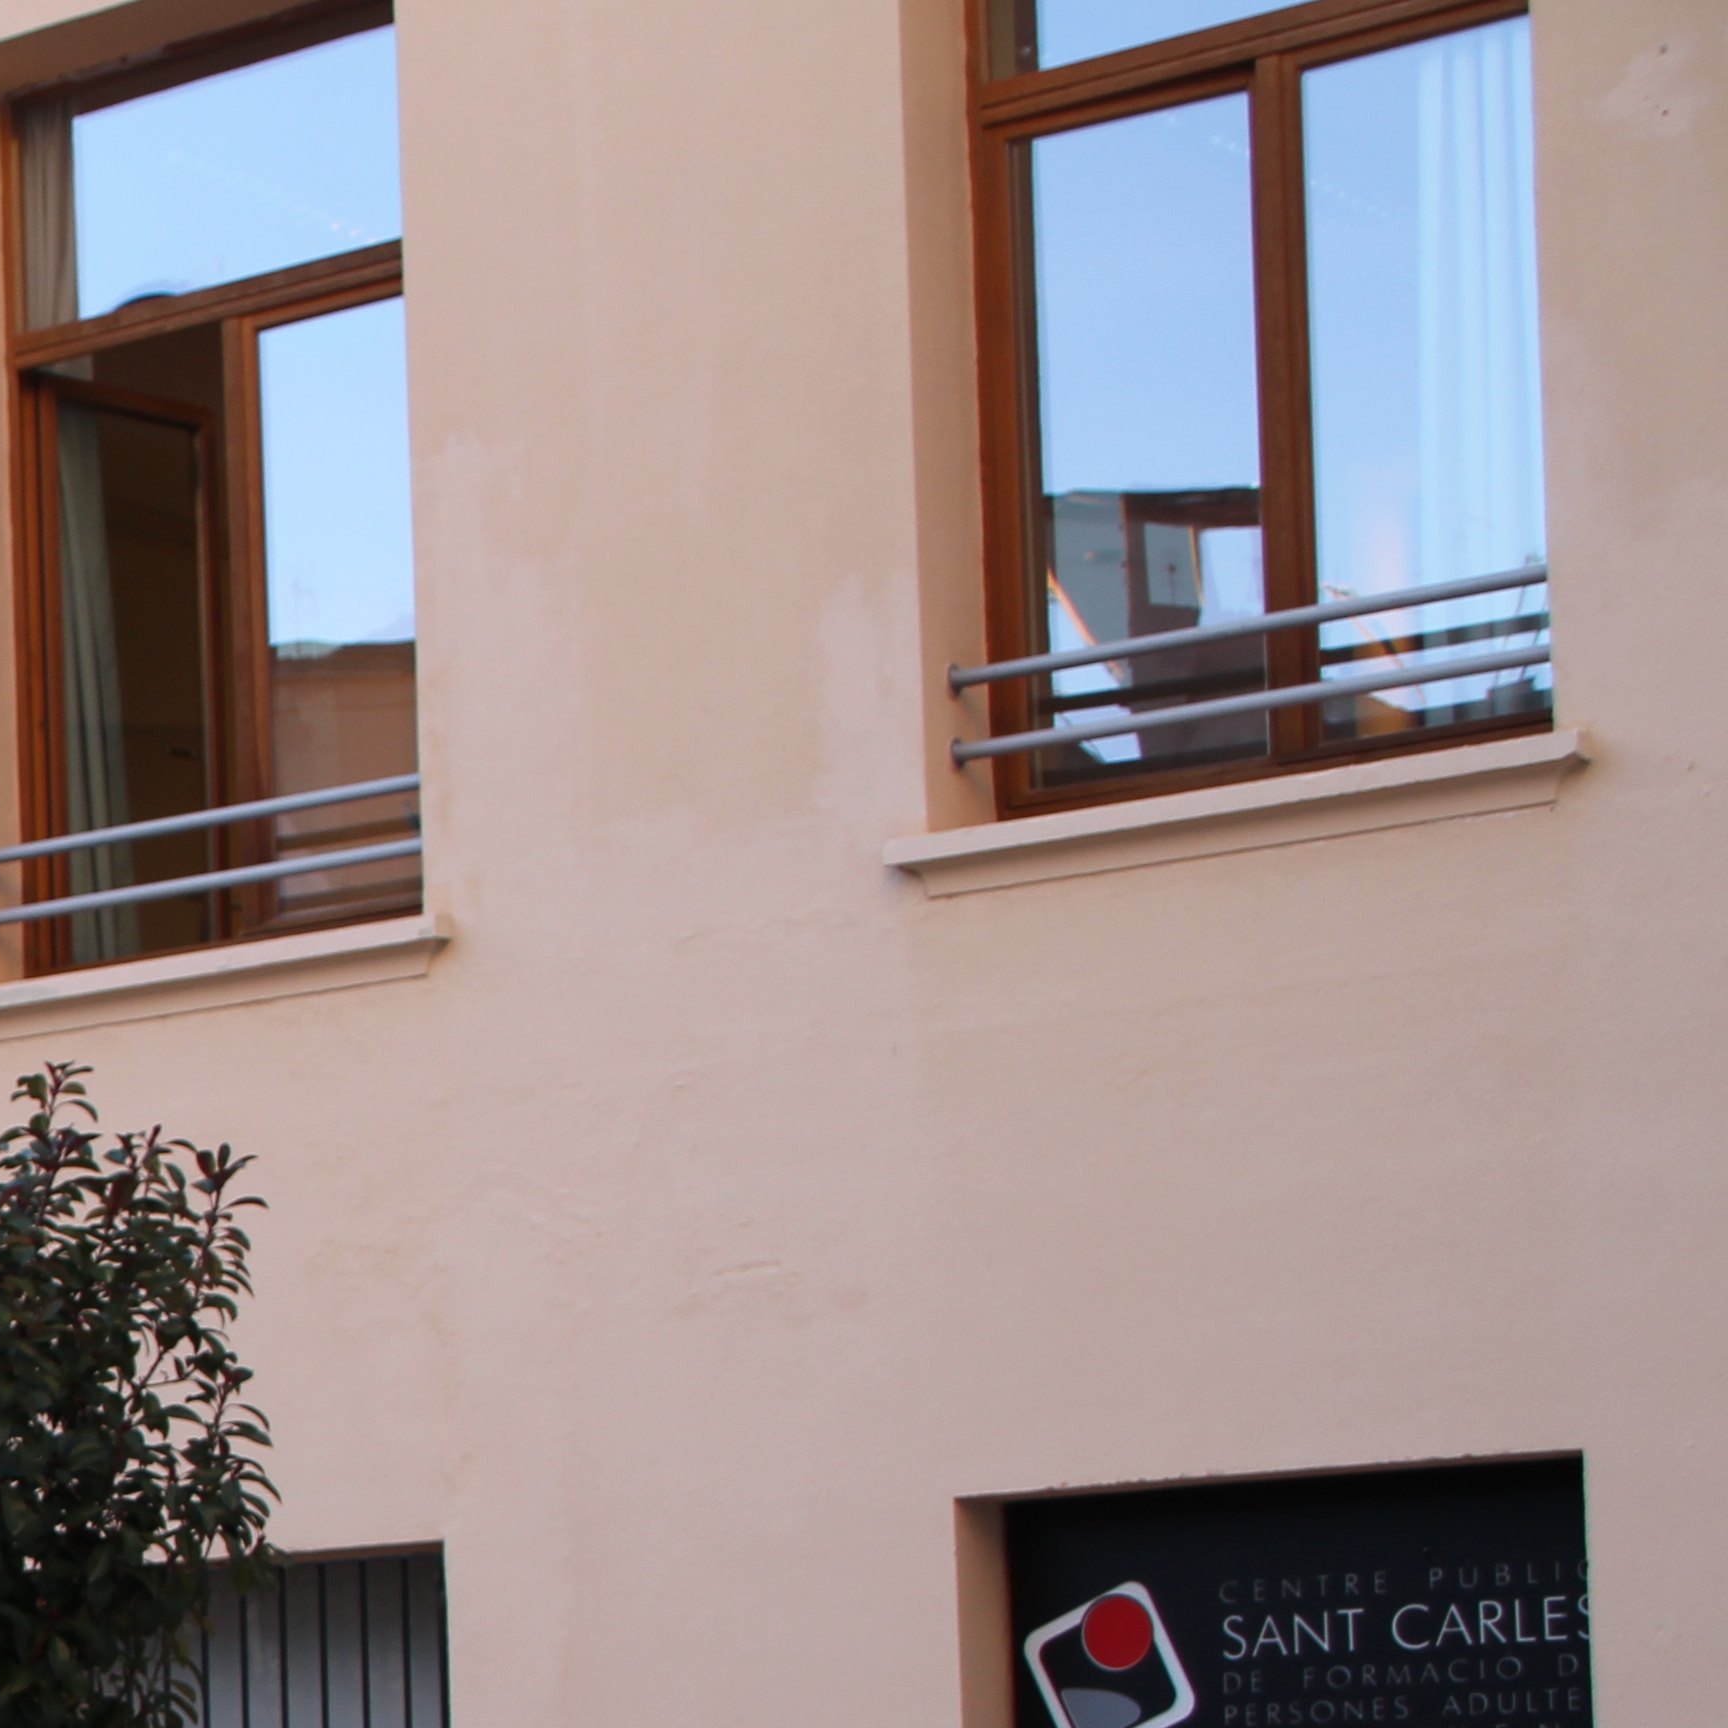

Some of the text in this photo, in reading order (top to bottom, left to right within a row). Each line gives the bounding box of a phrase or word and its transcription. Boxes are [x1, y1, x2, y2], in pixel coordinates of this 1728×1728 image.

[1218, 1570, 1387, 1605] CENTRE
[1222, 1606, 1366, 1661] SANT
[1222, 1669, 1264, 1695] DE
[1557, 1653, 1580, 1678] D
[1223, 1686, 1582, 1726] PERSONES ADULTE
